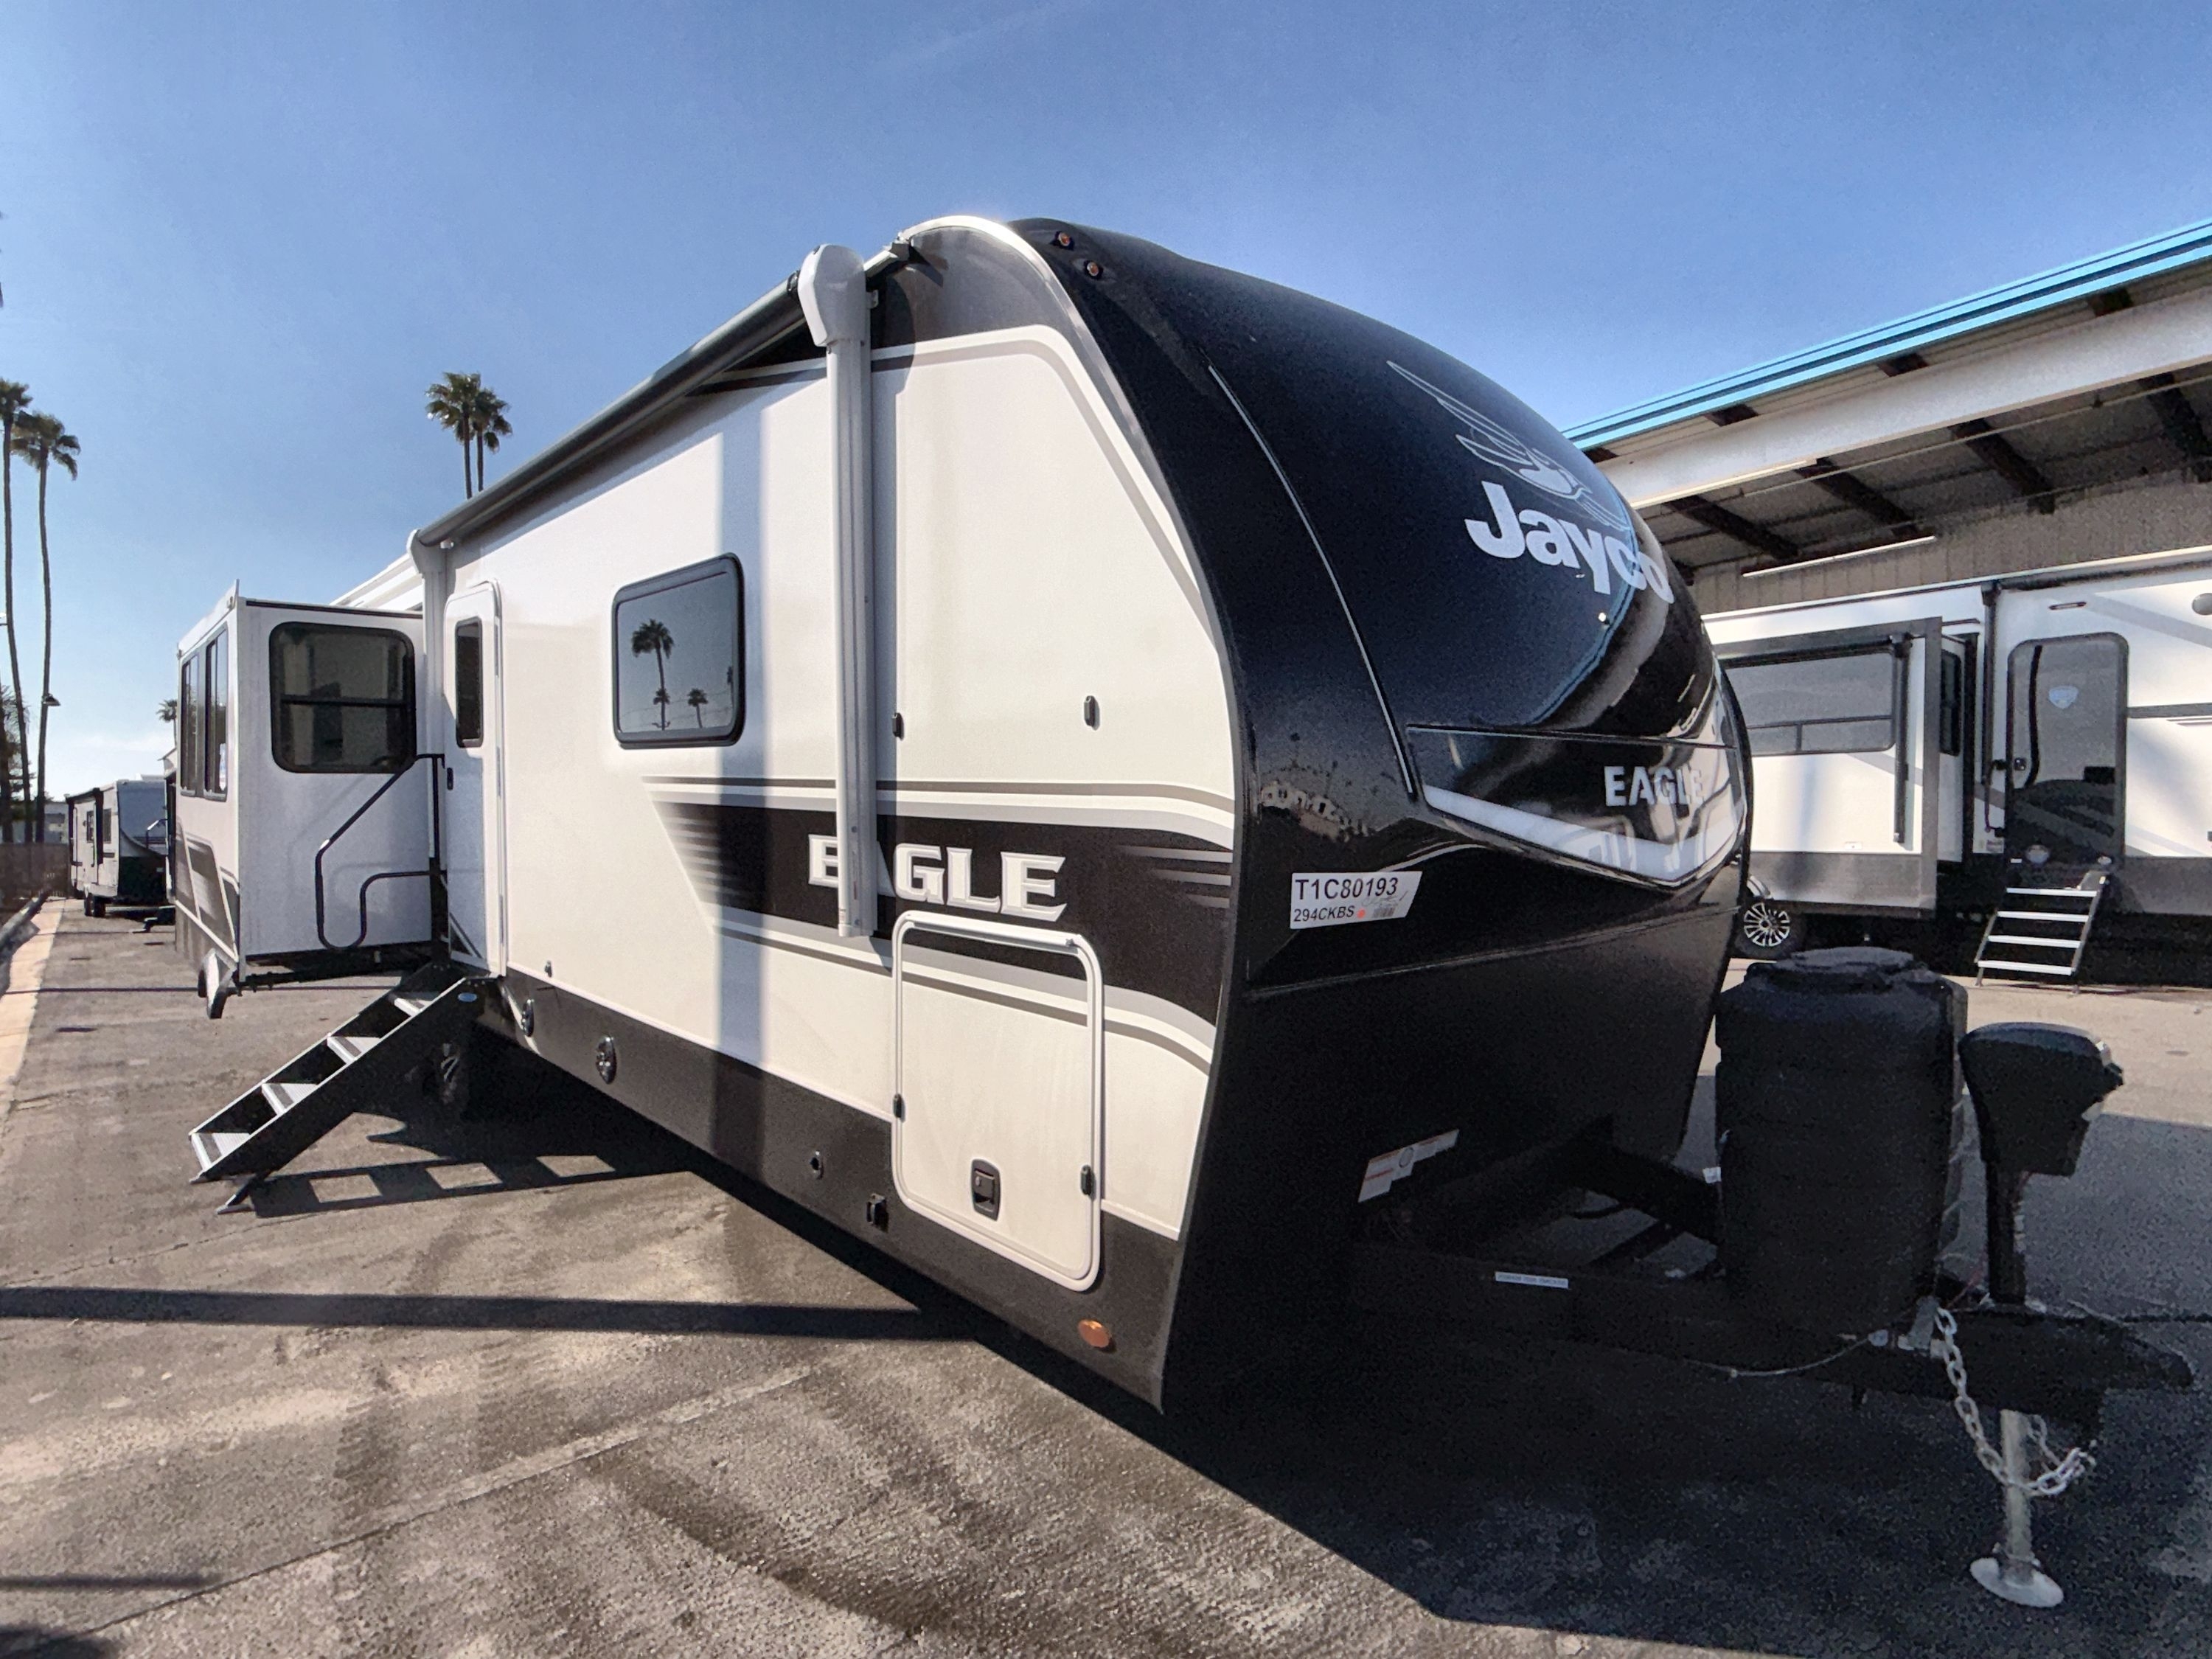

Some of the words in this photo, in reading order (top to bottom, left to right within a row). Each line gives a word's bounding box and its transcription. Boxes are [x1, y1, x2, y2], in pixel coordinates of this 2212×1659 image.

[1464, 481, 1674, 603] Jayco
[1604, 766, 1705, 807] EAGLE
[808, 834, 1067, 922] EGLE
[1295, 877, 1398, 900] T1C80193
[1294, 905, 1355, 922] 294CKBS
